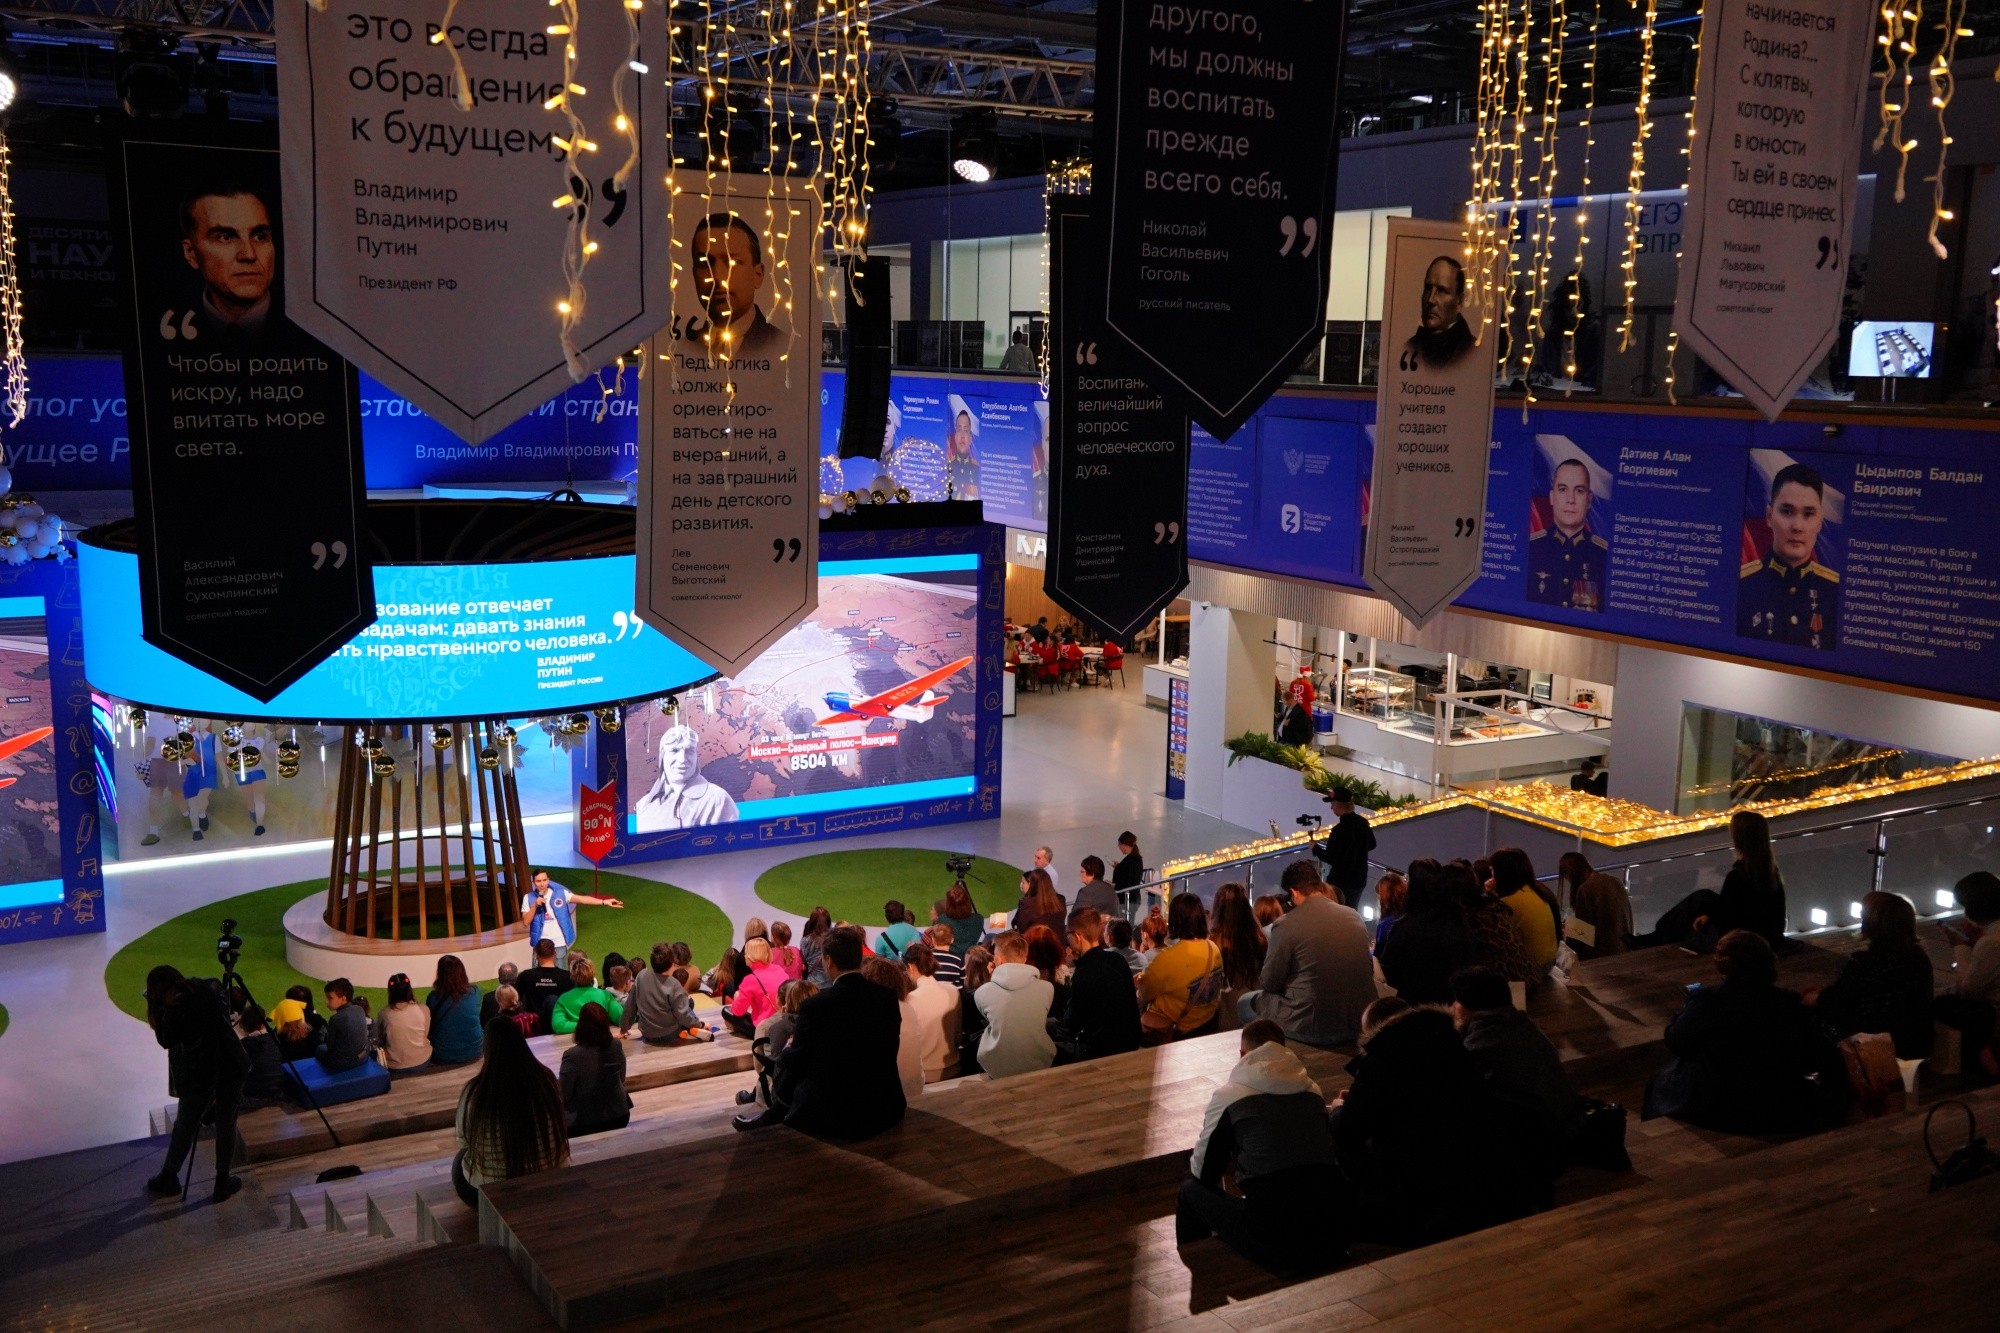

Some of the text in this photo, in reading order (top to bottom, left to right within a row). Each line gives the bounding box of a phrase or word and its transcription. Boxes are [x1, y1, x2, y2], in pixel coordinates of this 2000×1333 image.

[1149, 3, 1263, 43] другого,
[1746, 5, 1836, 32] начинается
[347, 13, 548, 60] это всегда
[1743, 30, 1819, 62] Родина?...
[1150, 46, 1294, 81] мы должны
[1740, 64, 1814, 98] С клятвы,
[1148, 87, 1275, 120] воспитать
[1737, 100, 1806, 128] которую
[351, 117, 371, 141] к
[1147, 129, 1249, 159] прежде
[1735, 134, 1807, 156] в юности
[1145, 170, 1289, 200] всего себя.
[1731, 161, 1838, 191] Ты ей в своем
[354, 179, 457, 203] Владимир
[1728, 197, 1837, 222] сердце принес
[355, 208, 508, 232] Владимирович
[1143, 219, 1207, 237] Николай
[357, 236, 417, 258] Путин
[1142, 243, 1229, 262] Васильевич
[1724, 241, 1761, 253] Михаил
[1140, 266, 1189, 282] Гоголь
[1720, 260, 1765, 273] Львович
[358, 275, 457, 291] Президент РФ
[1719, 278, 1786, 293] Матусовский
[1139, 298, 1232, 312] русский писатель
[167, 352, 328, 376] Чтобы родить
[674, 355, 771, 372] Педагогика
[171, 384, 304, 404] искру, надо
[1401, 381, 1456, 396] Хорошие
[672, 404, 774, 421] ориентиро-
[1078, 395, 1163, 413] величайший
[1400, 403, 1445, 416] учителя
[173, 410, 325, 430] впитать море
[1078, 421, 1129, 435] вопрос
[1399, 422, 1448, 434] создают
[672, 426, 777, 440] ваться не на
[175, 440, 244, 458] света.
[415, 442, 620, 460] Владимир Владимирович
[672, 446, 786, 465] вчерашний, а
[1077, 440, 1175, 456] человеческого
[1398, 442, 1449, 455] хороших
[1620, 447, 1692, 463] Датиев Алан
[1076, 464, 1112, 479] духа.
[1395, 460, 1454, 475] учеников.
[1619, 462, 1678, 478] Георгиевич
[1856, 463, 1983, 484] Цыдыпов Балдан
[672, 473, 692, 485] на
[1853, 481, 1922, 497] Баирович
[671, 493, 792, 509] день детского
[672, 517, 753, 534] развития.
[1614, 524, 1630, 533] ВКС
[1076, 532, 1121, 543] Константин
[1638, 538, 1656, 547] СВО
[672, 549, 691, 558] Лев
[1075, 545, 1124, 557] Дмитриевич
[1848, 538, 1978, 559] Получил контузию в бою в
[183, 555, 236, 572] Василий
[672, 562, 730, 573] Семенович
[1076, 556, 1115, 567] Ушинский
[1683, 565, 1706, 576] Всего
[1847, 551, 1972, 572] лесном массиве. Придя в
[185, 571, 284, 587] Александрович
[672, 575, 726, 586] Выготский
[1847, 563, 1997, 588] себя, открыл огонь из пушки и
[185, 584, 279, 604] Сухомлинский
[1846, 577, 1948, 595] пулемета, уничтожил
[465, 597, 553, 613] отвечает
[671, 594, 743, 602] советский психолог
[1845, 588, 1960, 610] единиц бронетехники и
[1844, 600, 1947, 621] пулеметных расчетов
[453, 618, 520, 637] давать
[524, 615, 586, 632] знания
[1843, 613, 1995, 641] и десятки человек живой силы
[367, 630, 613, 662] нравственного человека.
[1843, 625, 1982, 651] противника. Спас жизни 150
[1843, 636, 1937, 658] боевым товарищам.
[537, 653, 596, 668] ВЛАДИМИР
[537, 667, 573, 679] ПУТИН
[790, 752, 828, 772] 8504
